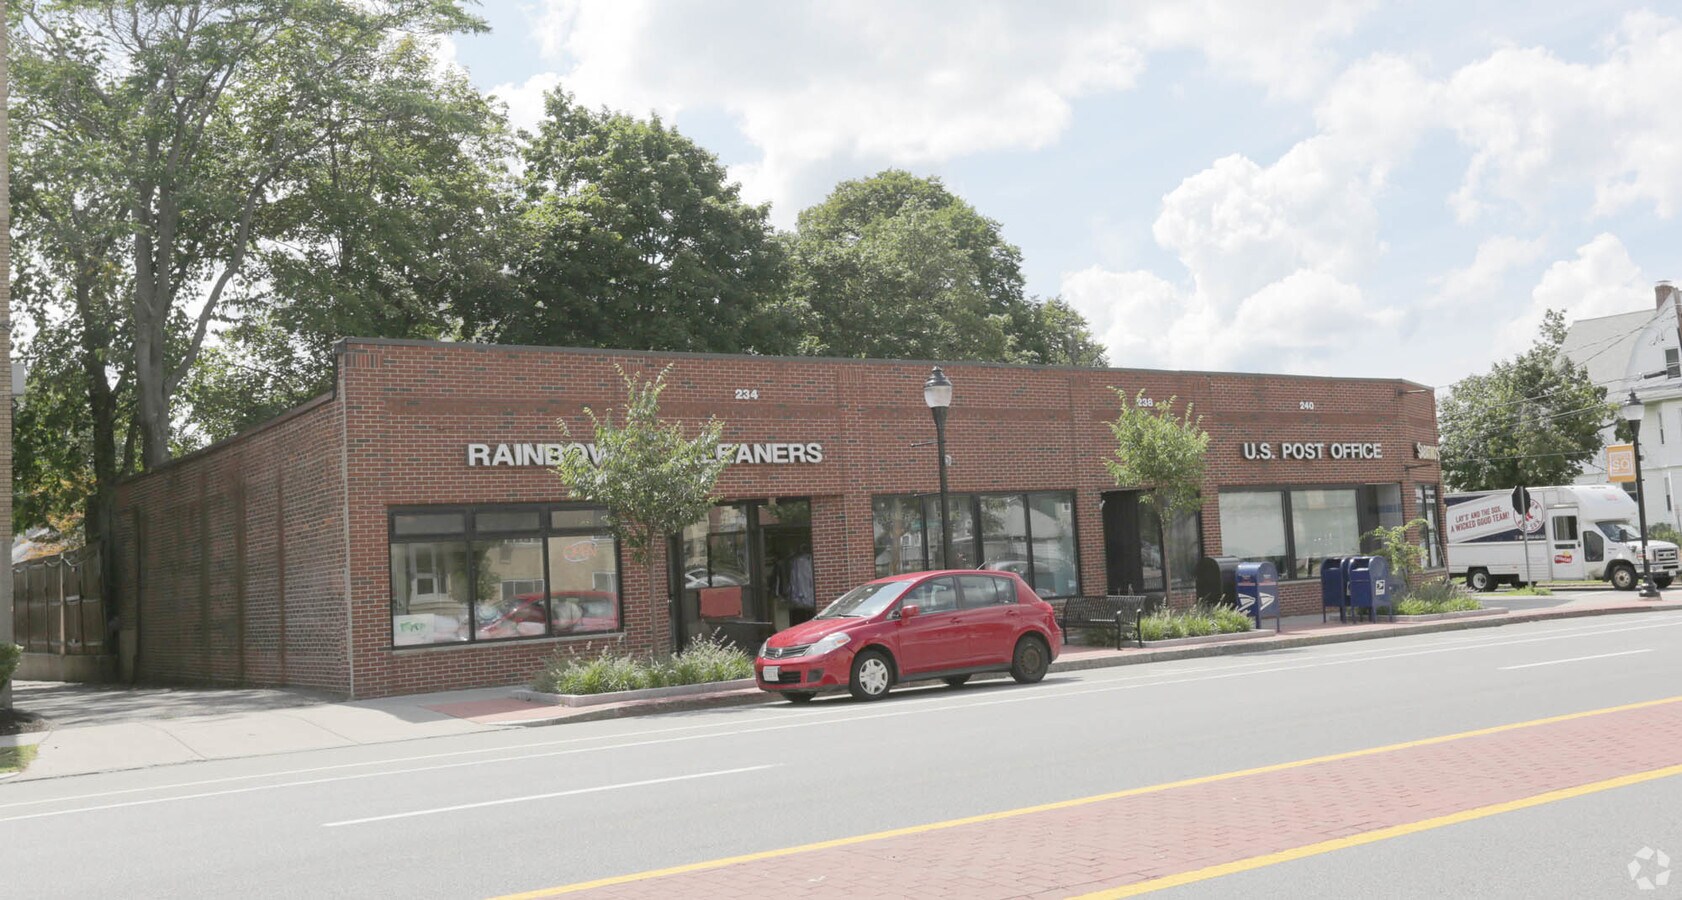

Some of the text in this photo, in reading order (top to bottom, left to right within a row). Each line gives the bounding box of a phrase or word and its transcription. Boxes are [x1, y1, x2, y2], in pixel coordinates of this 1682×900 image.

[735, 389, 758, 400] 234
[1137, 398, 1153, 407] 238
[1299, 401, 1314, 410] 240
[697, 443, 823, 464] LEANERS
[1244, 443, 1383, 460] U.S. POST OFFICE
[1471, 511, 1480, 519] AND
[1481, 508, 1490, 516] THE
[1451, 511, 1510, 533] A WICKED GOOD TEAM!
